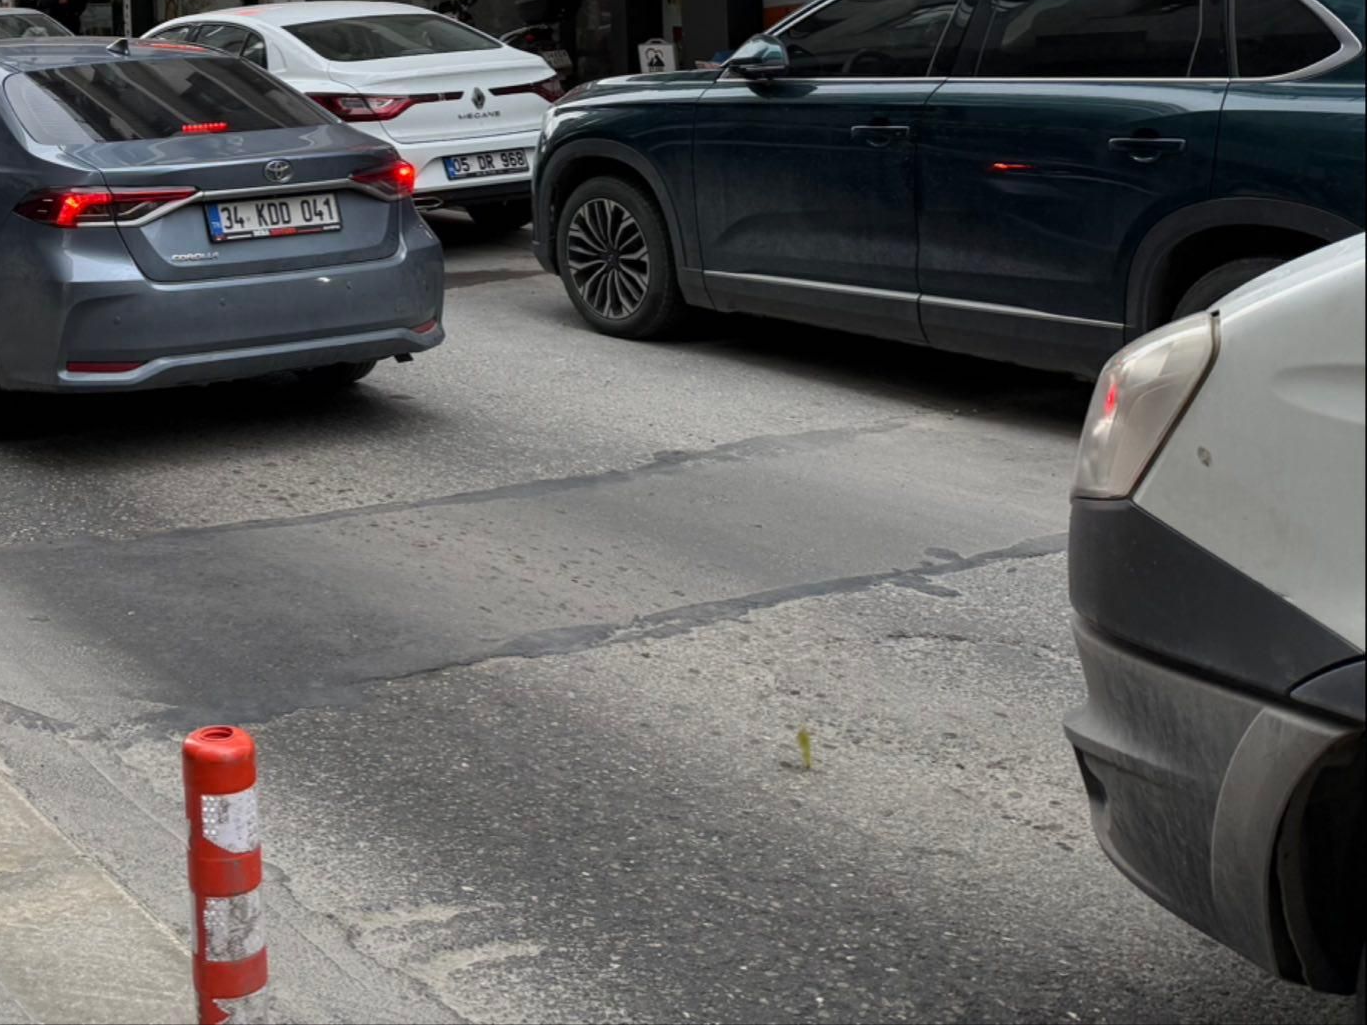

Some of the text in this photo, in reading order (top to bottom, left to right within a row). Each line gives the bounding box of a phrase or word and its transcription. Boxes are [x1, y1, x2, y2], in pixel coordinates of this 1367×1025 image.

[454, 151, 525, 172] 05 DR 968
[221, 198, 334, 229] 34 KDD 041
